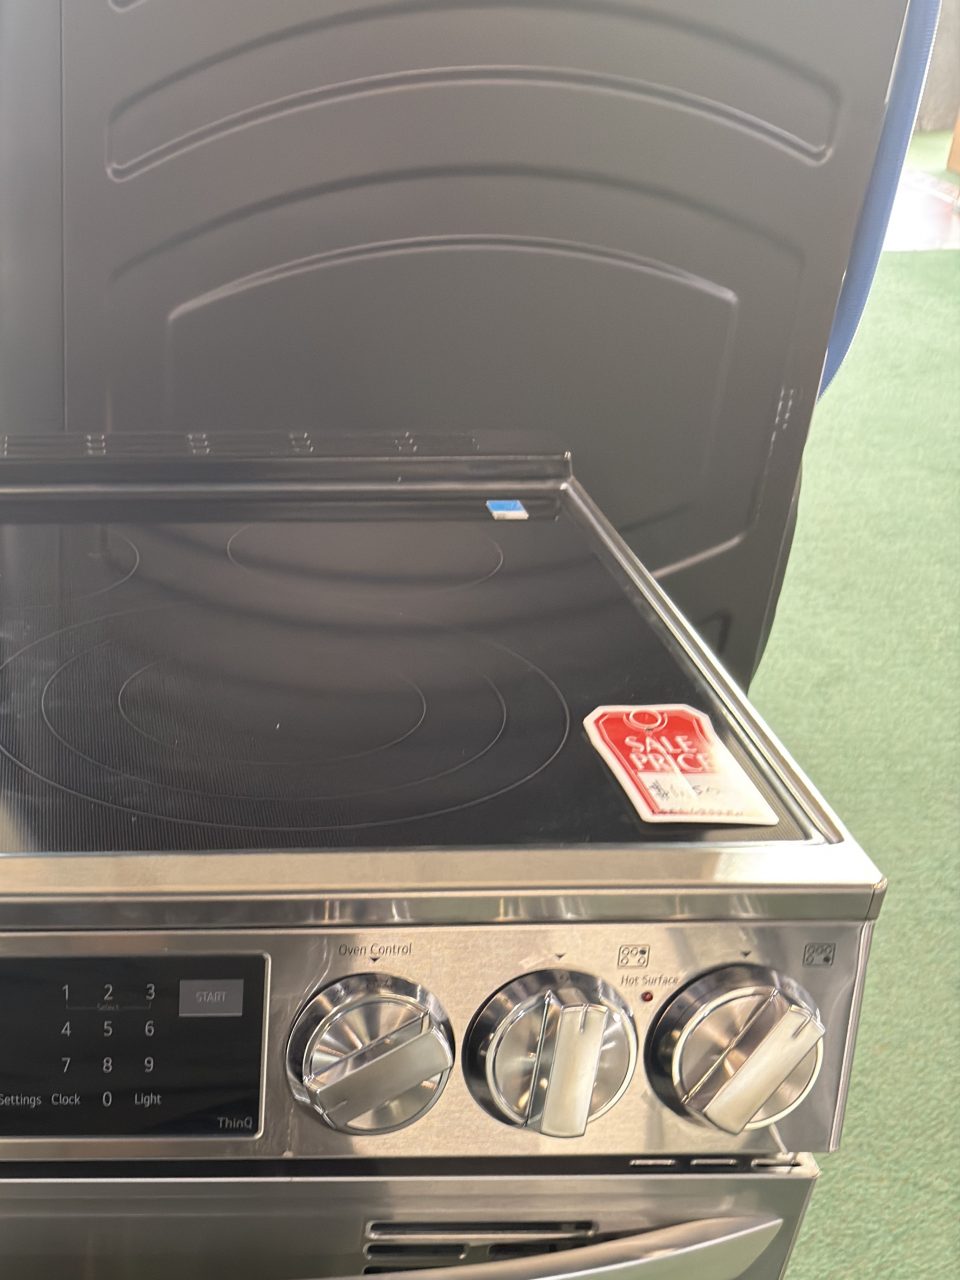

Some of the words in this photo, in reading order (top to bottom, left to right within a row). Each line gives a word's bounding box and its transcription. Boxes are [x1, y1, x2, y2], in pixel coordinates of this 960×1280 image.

[623, 735, 698, 753] SALE
[628, 753, 716, 771] PRICE
[338, 943, 367, 955] Oven
[370, 943, 413, 955] Control
[621, 975, 638, 985] Hot
[641, 974, 679, 985] Surface
[61, 984, 69, 1000] 1
[104, 983, 113, 1000] 2
[146, 983, 156, 1000] 3
[195, 991, 226, 1002] START
[60, 1021, 71, 1037] 4
[103, 1020, 113, 1037] 5
[145, 1020, 155, 1037] 6
[61, 1057, 71, 1073] 7
[102, 1056, 113, 1073] 8
[144, 1056, 154, 1073] 9
[51, 1093, 81, 1106] Clock
[102, 1091, 113, 1107] 0
[134, 1093, 162, 1108] Light
[217, 1116, 253, 1130] ThinQ
